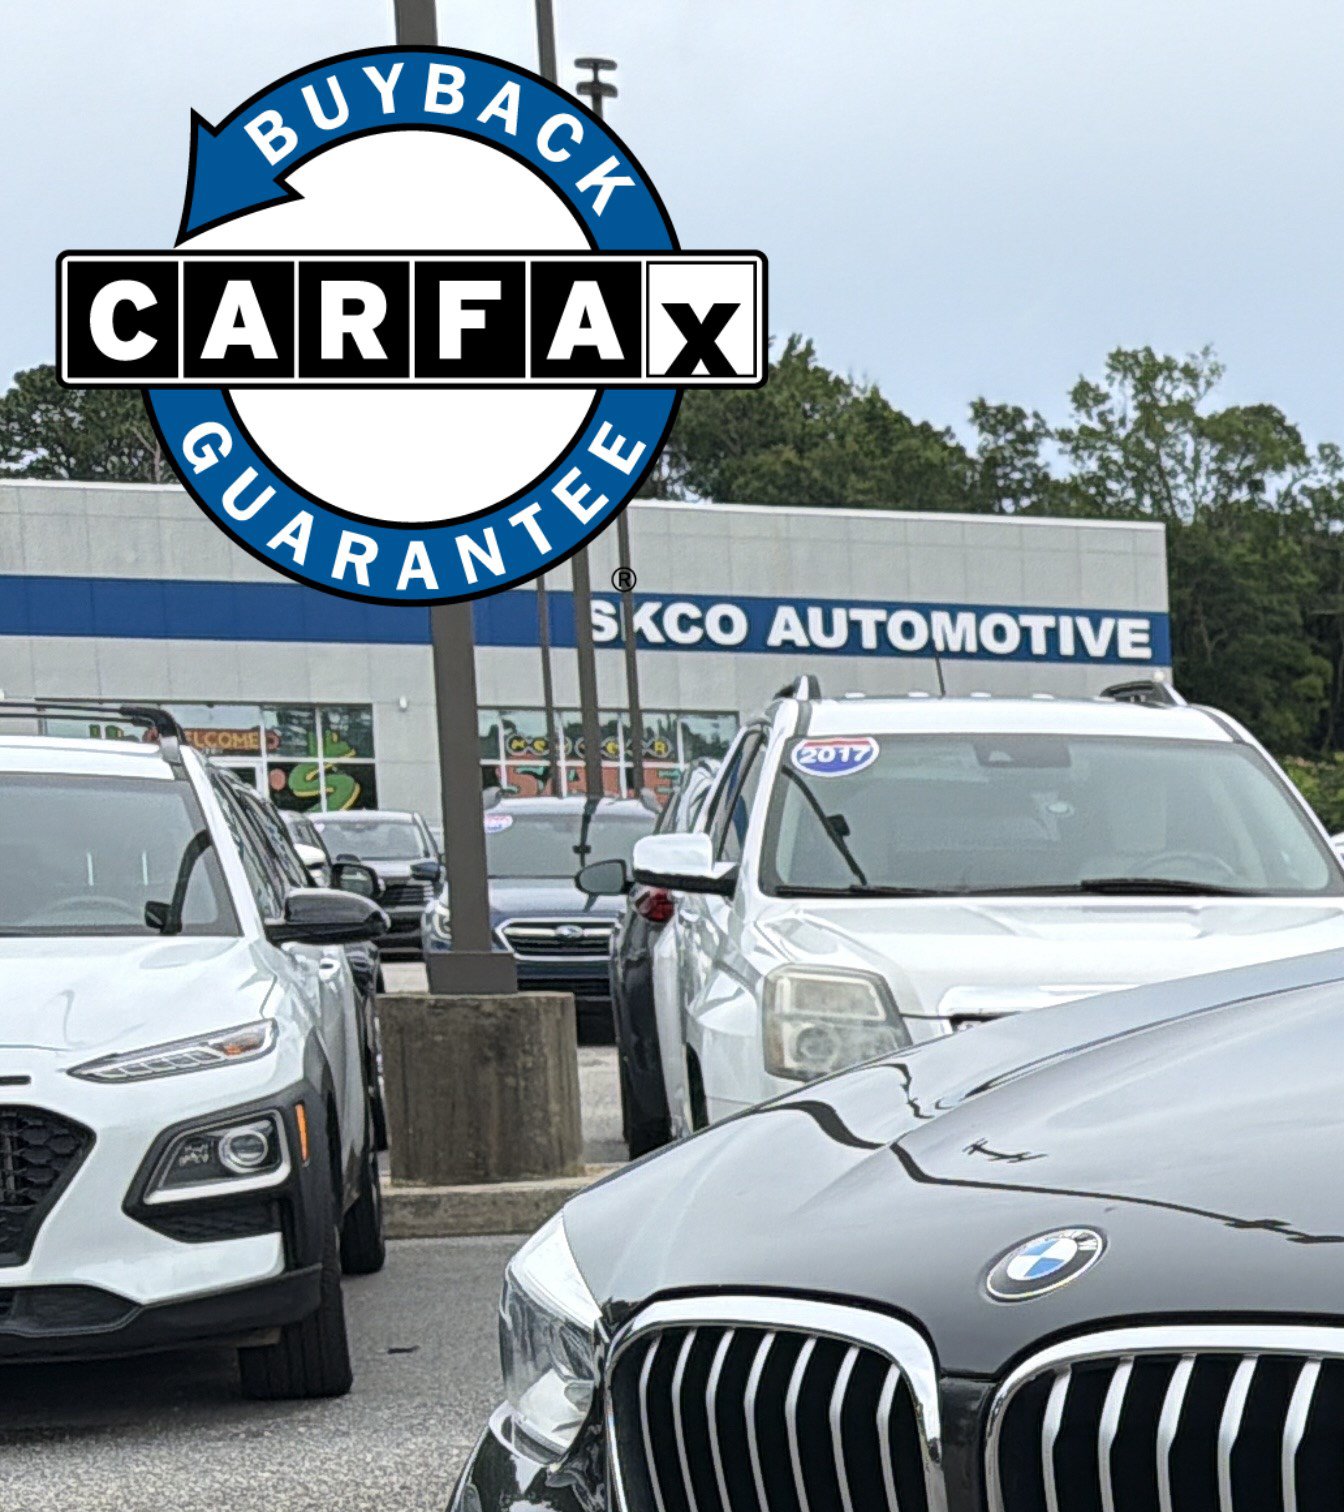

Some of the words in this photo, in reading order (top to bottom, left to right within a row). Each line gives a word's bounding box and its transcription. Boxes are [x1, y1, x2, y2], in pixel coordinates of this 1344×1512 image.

[590, 600, 748, 646] SKCO
[767, 605, 1152, 659] AUTOMOTIVE
[799, 746, 871, 764] 2017
